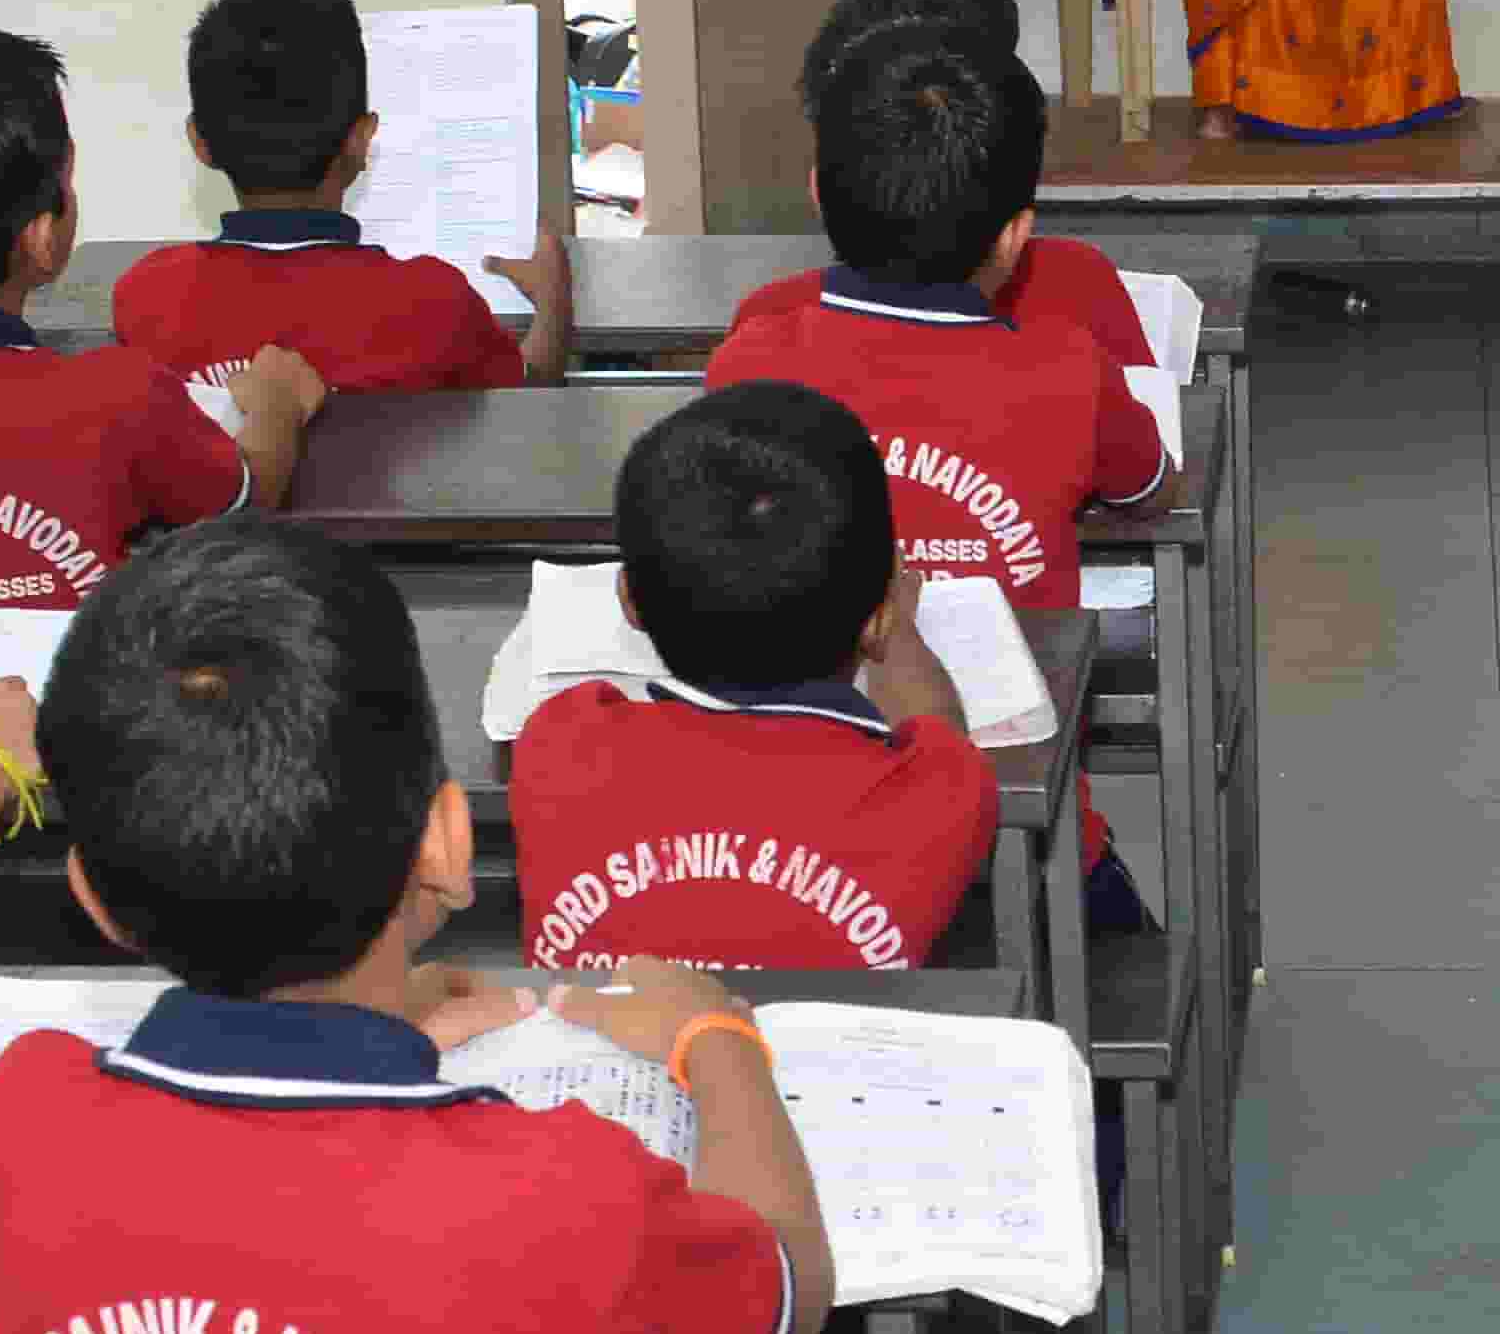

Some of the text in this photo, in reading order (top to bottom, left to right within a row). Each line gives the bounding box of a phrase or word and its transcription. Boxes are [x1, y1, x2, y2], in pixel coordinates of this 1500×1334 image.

[884, 436, 1045, 587] & NAVODAYA
[606, 832, 747, 898] SAINIK
[748, 838, 777, 885] &
